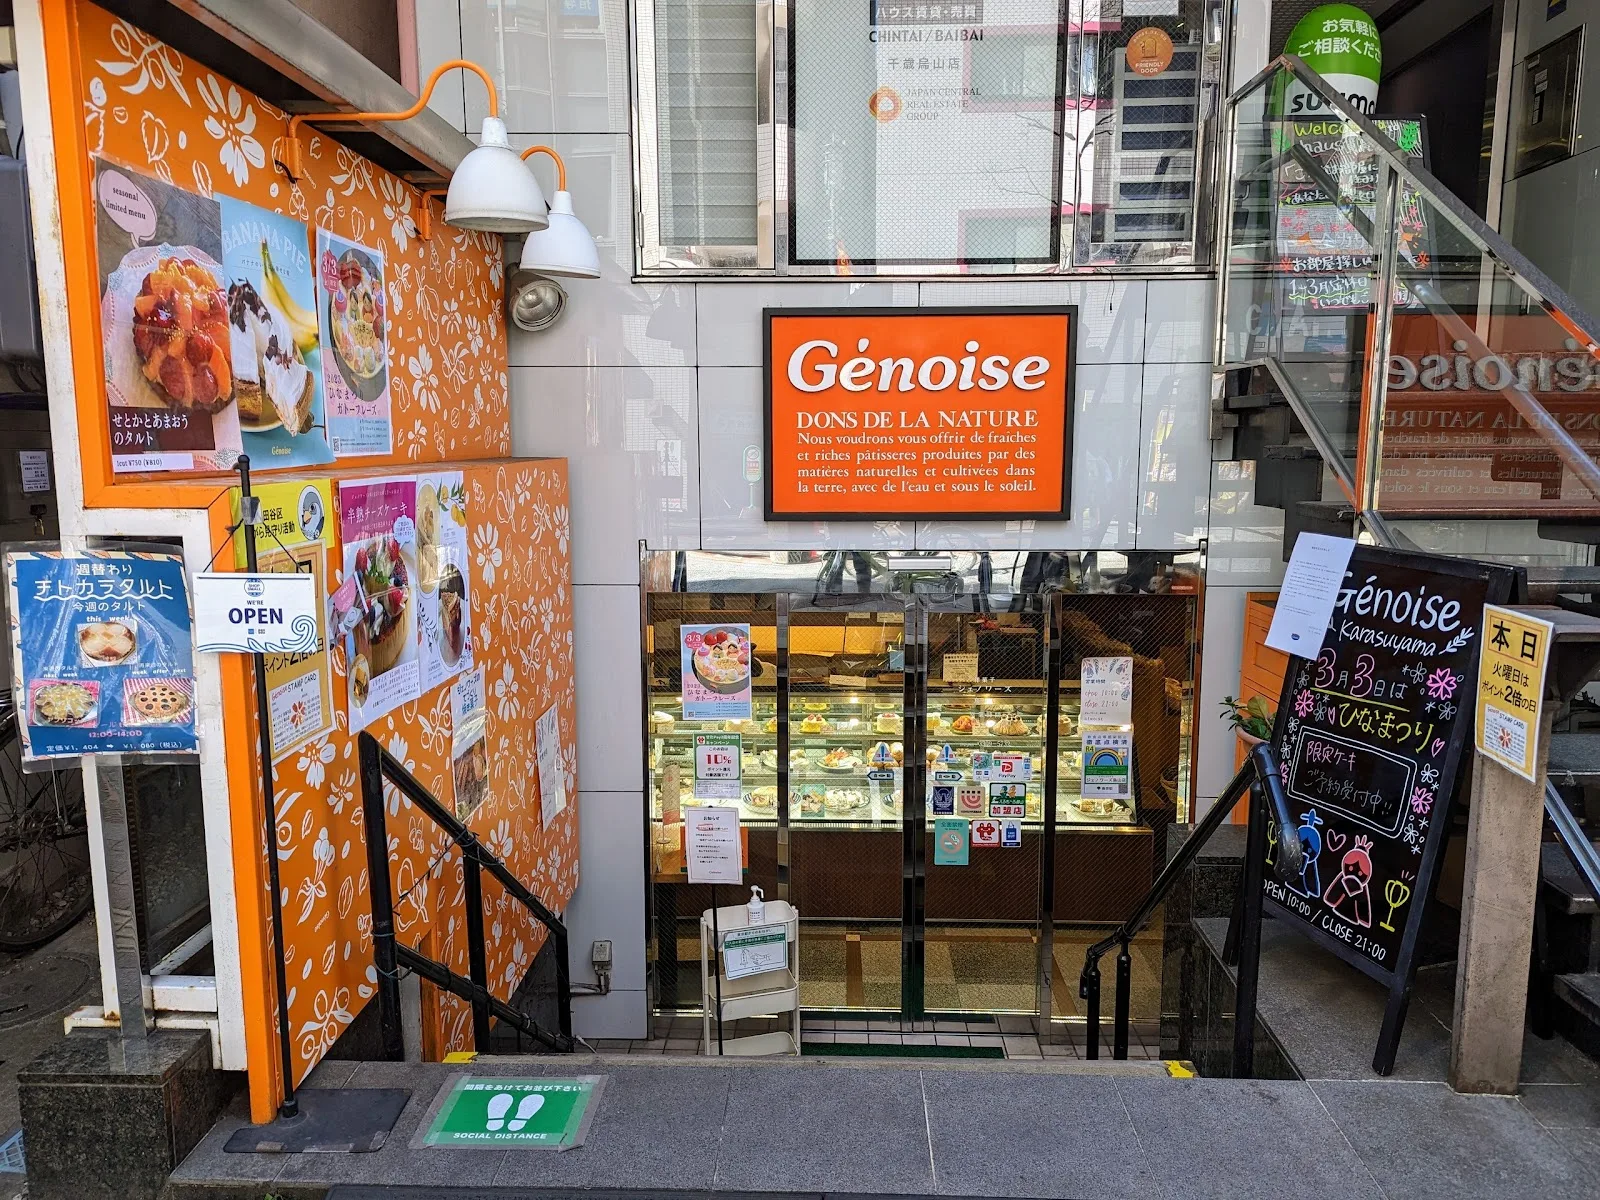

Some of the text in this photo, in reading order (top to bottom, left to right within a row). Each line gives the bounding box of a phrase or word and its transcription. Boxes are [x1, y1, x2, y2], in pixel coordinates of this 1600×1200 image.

[869, 29, 984, 42] CHINTAI BAIBAI
[1323, 18, 1379, 41] お気軽に
[938, 87, 982, 96] CENTRAL
[906, 100, 969, 109] REAL ESTATE
[1290, 92, 1377, 115] sumo
[906, 112, 939, 121] GROUP
[112, 187, 139, 202] seasonal
[105, 199, 146, 220] limited menu
[322, 256, 337, 276] 3/3
[787, 337, 1051, 393] Génoise
[337, 403, 377, 415] ガトーフレーズ
[112, 413, 189, 429] せとかとあまおう
[796, 410, 1039, 429] DONS DE LA NATURE
[114, 431, 154, 446] のタルト
[797, 431, 1037, 445] Nous voudrons vous offrir de fraîches
[797, 447, 1036, 464] et riches pâtisseres produites par des
[797, 463, 1036, 477] matières naturelles et cultivées dans
[797, 480, 1037, 495] la terre, avec de l'eau et sous le soleil.
[263, 507, 284, 521] 田谷区
[254, 521, 296, 539] がら見守り活動
[76, 563, 133, 576] 週替わり
[34, 579, 173, 597] チトカラタルト
[73, 601, 146, 612] 今週のタルト
[228, 608, 284, 625] OPEN
[686, 634, 701, 642] 3/3
[1339, 619, 1436, 656] Karasuyama
[1491, 620, 1538, 662] 本日
[304, 672, 317, 685] CARD
[1314, 648, 1409, 699] 3月3日は
[1492, 660, 1530, 688] 火曜日は
[1481, 680, 1537, 714] ポイント2倍の日
[1339, 703, 1435, 753] ひなまつり
[992, 806, 1022, 815] 加盟店
[1263, 879, 1286, 901] PEN
[1287, 890, 1311, 916] 10:00
[1322, 915, 1353, 942] CLOSE
[1355, 935, 1387, 961] 21:00
[463, 1083, 583, 1092] 間隔をあけてお並び下さい
[453, 1132, 491, 1140] SOCIAL
